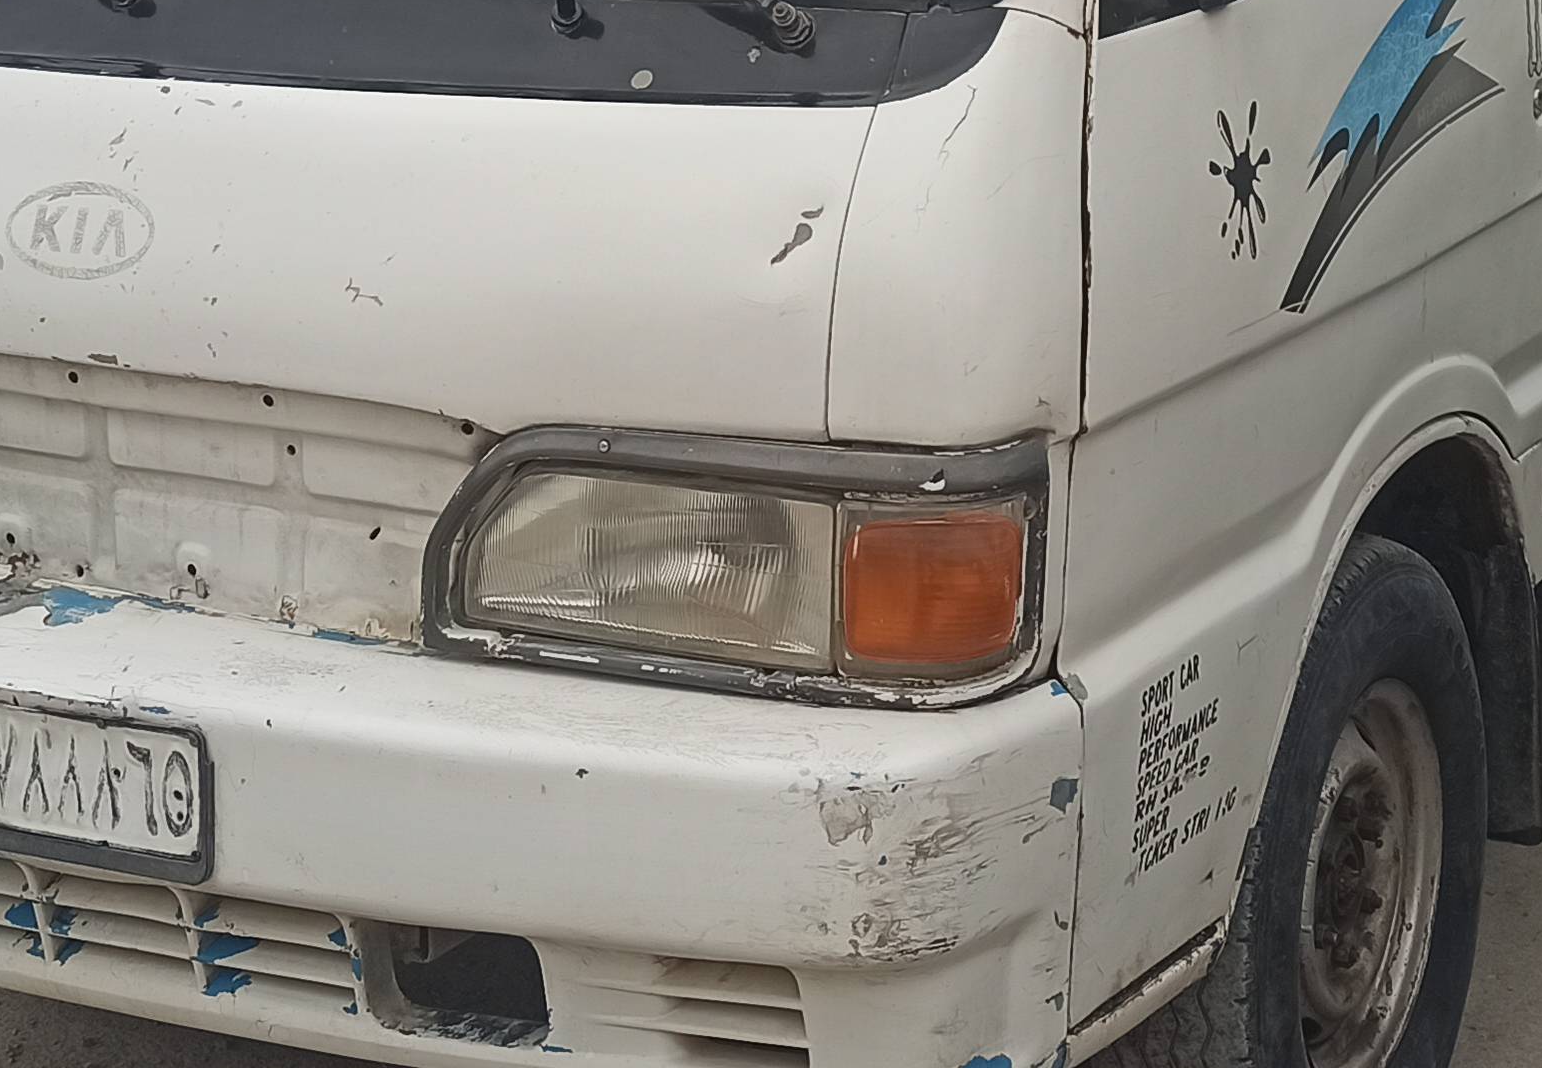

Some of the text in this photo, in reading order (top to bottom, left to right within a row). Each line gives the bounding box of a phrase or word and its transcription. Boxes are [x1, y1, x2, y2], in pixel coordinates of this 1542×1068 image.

[29, 204, 126, 258] KIA
[1141, 654, 1200, 717] SPORT CAR
[1138, 697, 1219, 775] PERFORMANCE
[1140, 701, 1173, 747] HIGH
[1136, 757, 1172, 802] SPEED
[1174, 737, 1199, 774] CAR
[1132, 805, 1170, 854] SUPER
[1135, 790, 1158, 823] RH
